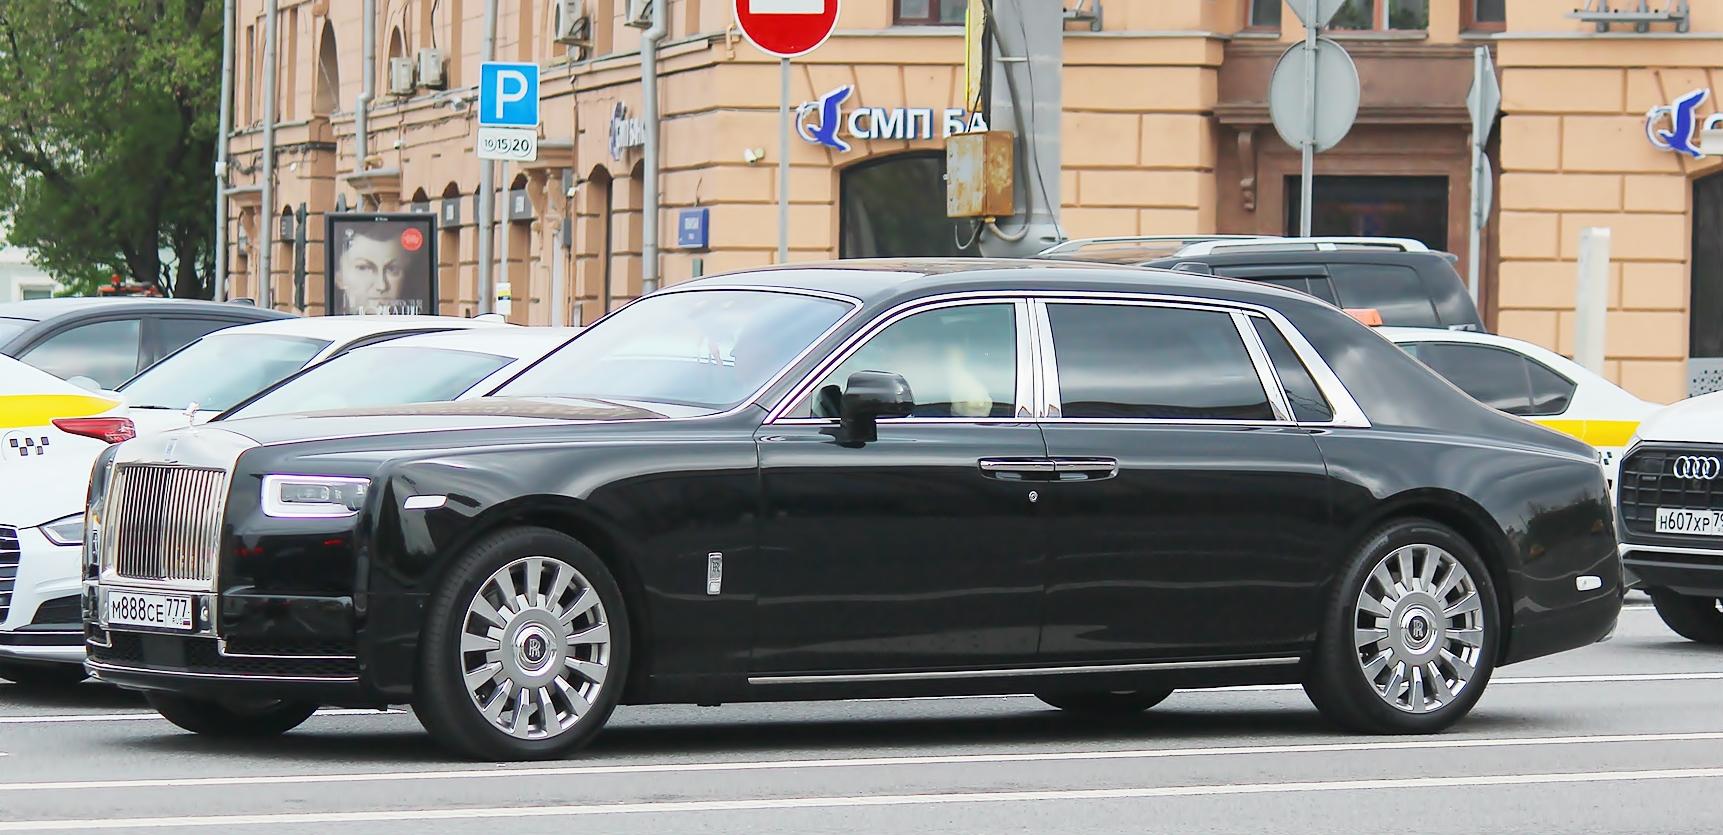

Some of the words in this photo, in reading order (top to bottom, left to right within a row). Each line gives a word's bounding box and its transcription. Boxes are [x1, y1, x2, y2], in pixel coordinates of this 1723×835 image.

[495, 69, 529, 119] P
[848, 107, 933, 139] СМП
[484, 138, 494, 148] 10
[497, 138, 509, 150] 15
[512, 138, 530, 152] 20
[1660, 511, 1710, 531] Н607ХР
[112, 596, 164, 623] М888СЕ
[166, 598, 187, 618] 777
